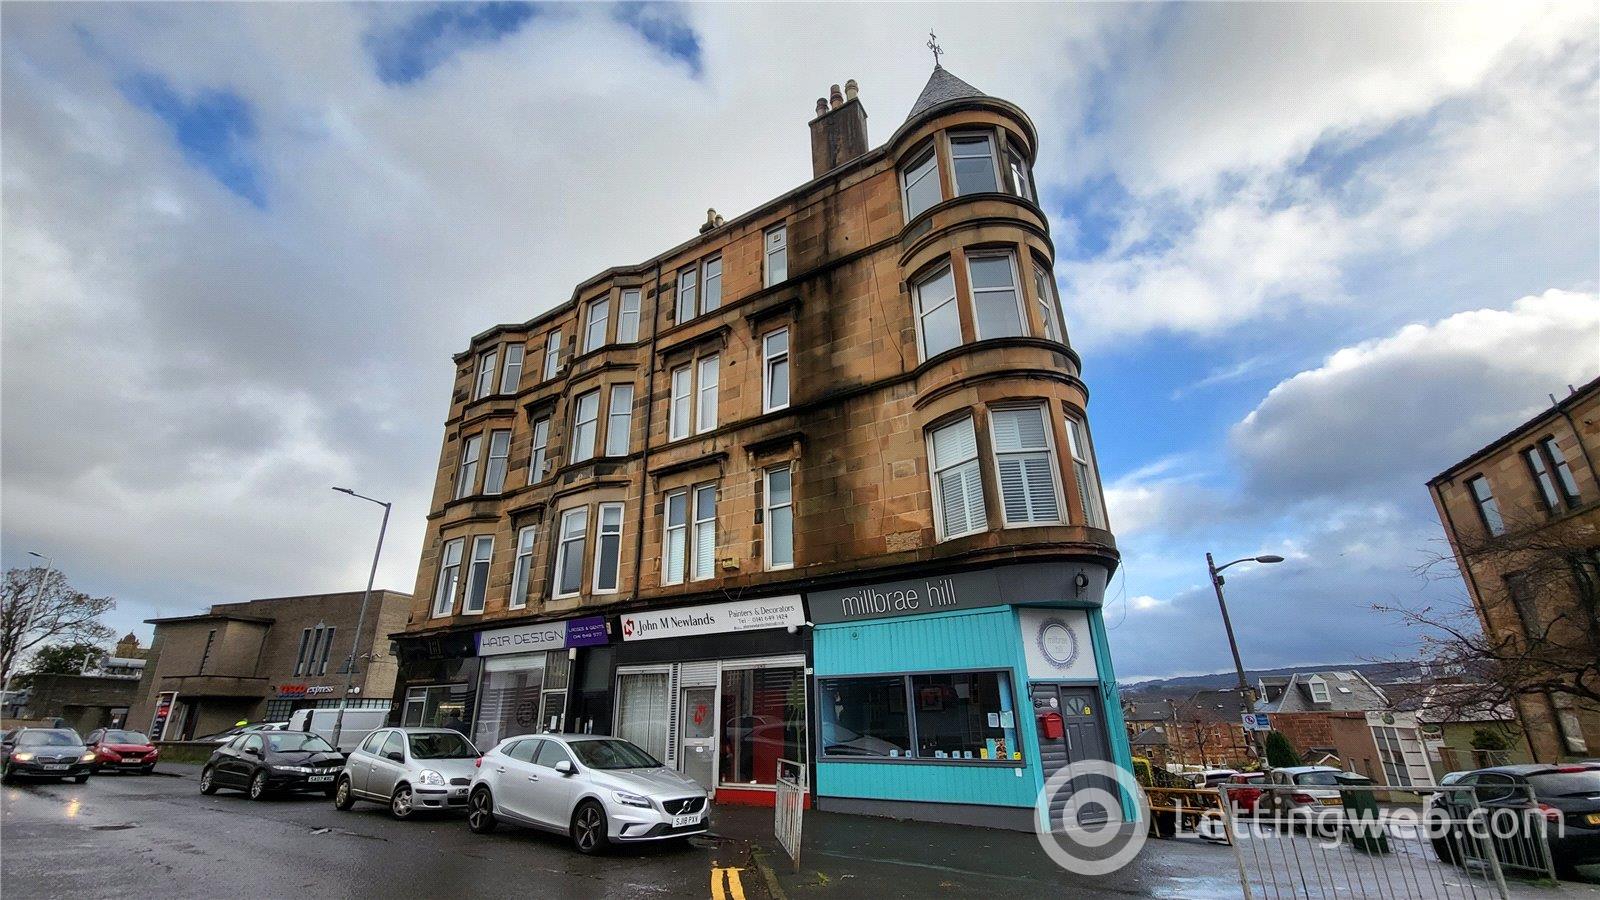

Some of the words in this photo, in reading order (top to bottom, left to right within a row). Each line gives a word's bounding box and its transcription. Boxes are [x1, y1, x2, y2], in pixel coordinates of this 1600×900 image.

[841, 588, 919, 616] millbrae
[926, 578, 957, 607] hill
[728, 608, 752, 618] Painters
[754, 608, 760, 616] &
[760, 605, 795, 615] Decorators
[637, 620, 658, 636] John
[660, 617, 669, 630] M
[671, 613, 715, 628] Newlands
[482, 636, 511, 648] HAIR
[513, 630, 564, 645] DESIGN
[306, 685, 334, 695] express
